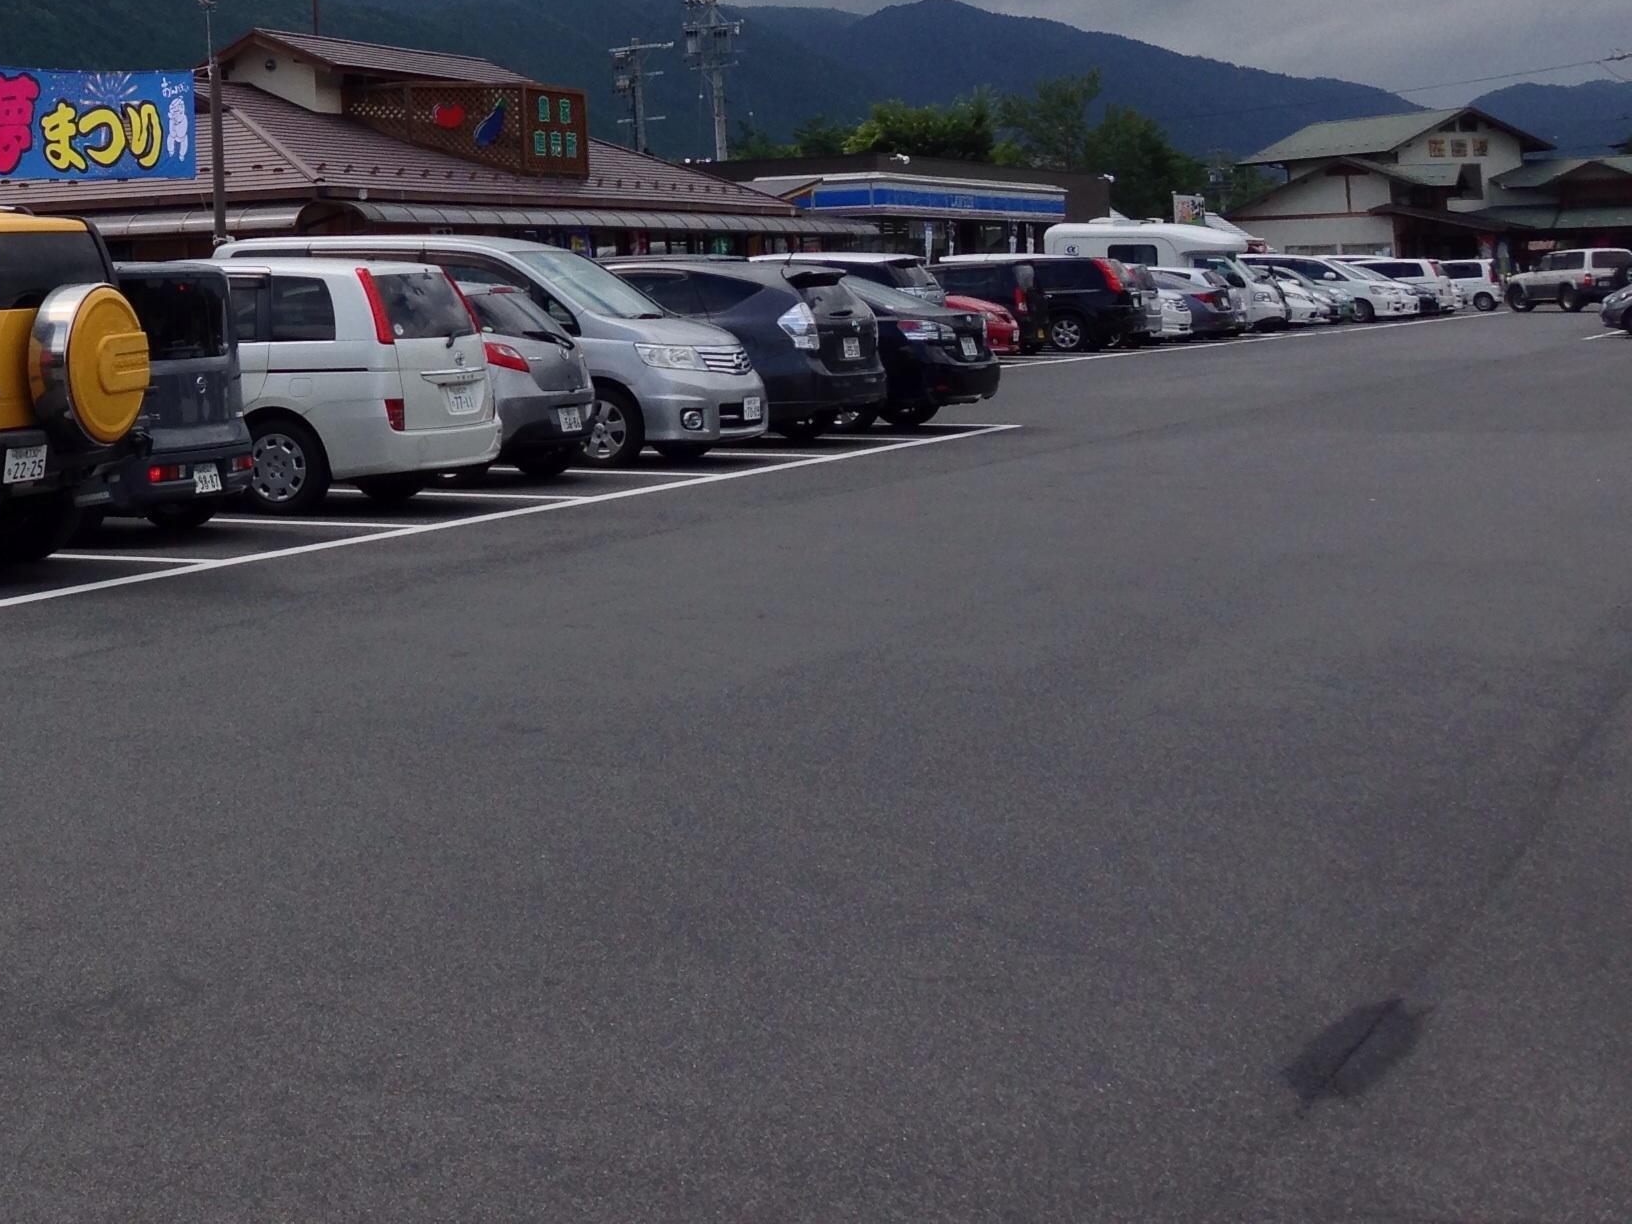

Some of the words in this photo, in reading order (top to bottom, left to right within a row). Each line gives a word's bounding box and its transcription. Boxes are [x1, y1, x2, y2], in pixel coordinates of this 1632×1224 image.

[534, 130, 578, 158] 直売所
[13, 459, 44, 479] 22-25
